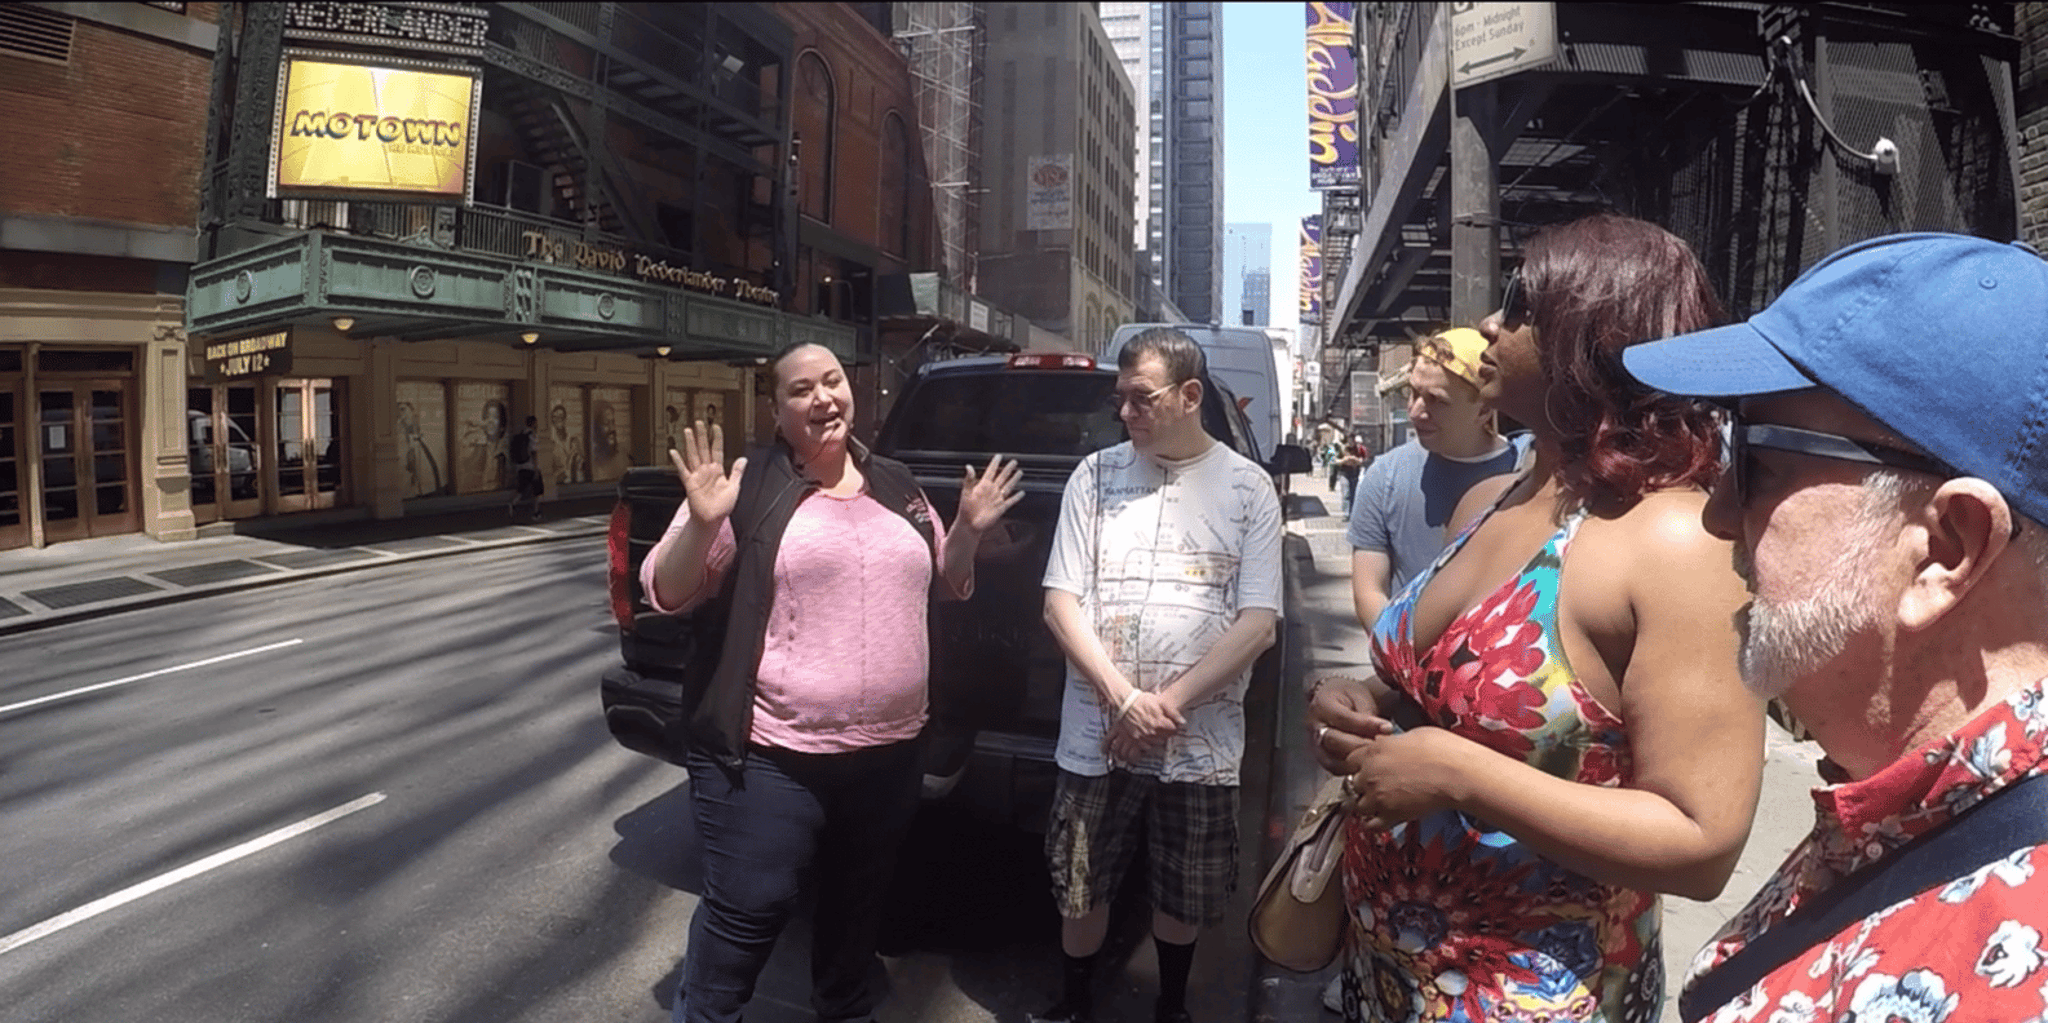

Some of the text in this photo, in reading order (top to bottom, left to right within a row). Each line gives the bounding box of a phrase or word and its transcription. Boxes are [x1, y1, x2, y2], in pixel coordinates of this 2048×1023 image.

[284, 2, 489, 46] NEDERLANDER
[1483, 5, 1521, 26] Midnight
[1455, 21, 1524, 52] Except Sunday
[290, 109, 461, 147] MOTOWN
[522, 231, 563, 260] The
[575, 240, 626, 271] David
[240, 331, 287, 354] BROADWAY
[226, 353, 264, 377] JULY 12
[1104, 486, 1158, 496] MANHATTAN
